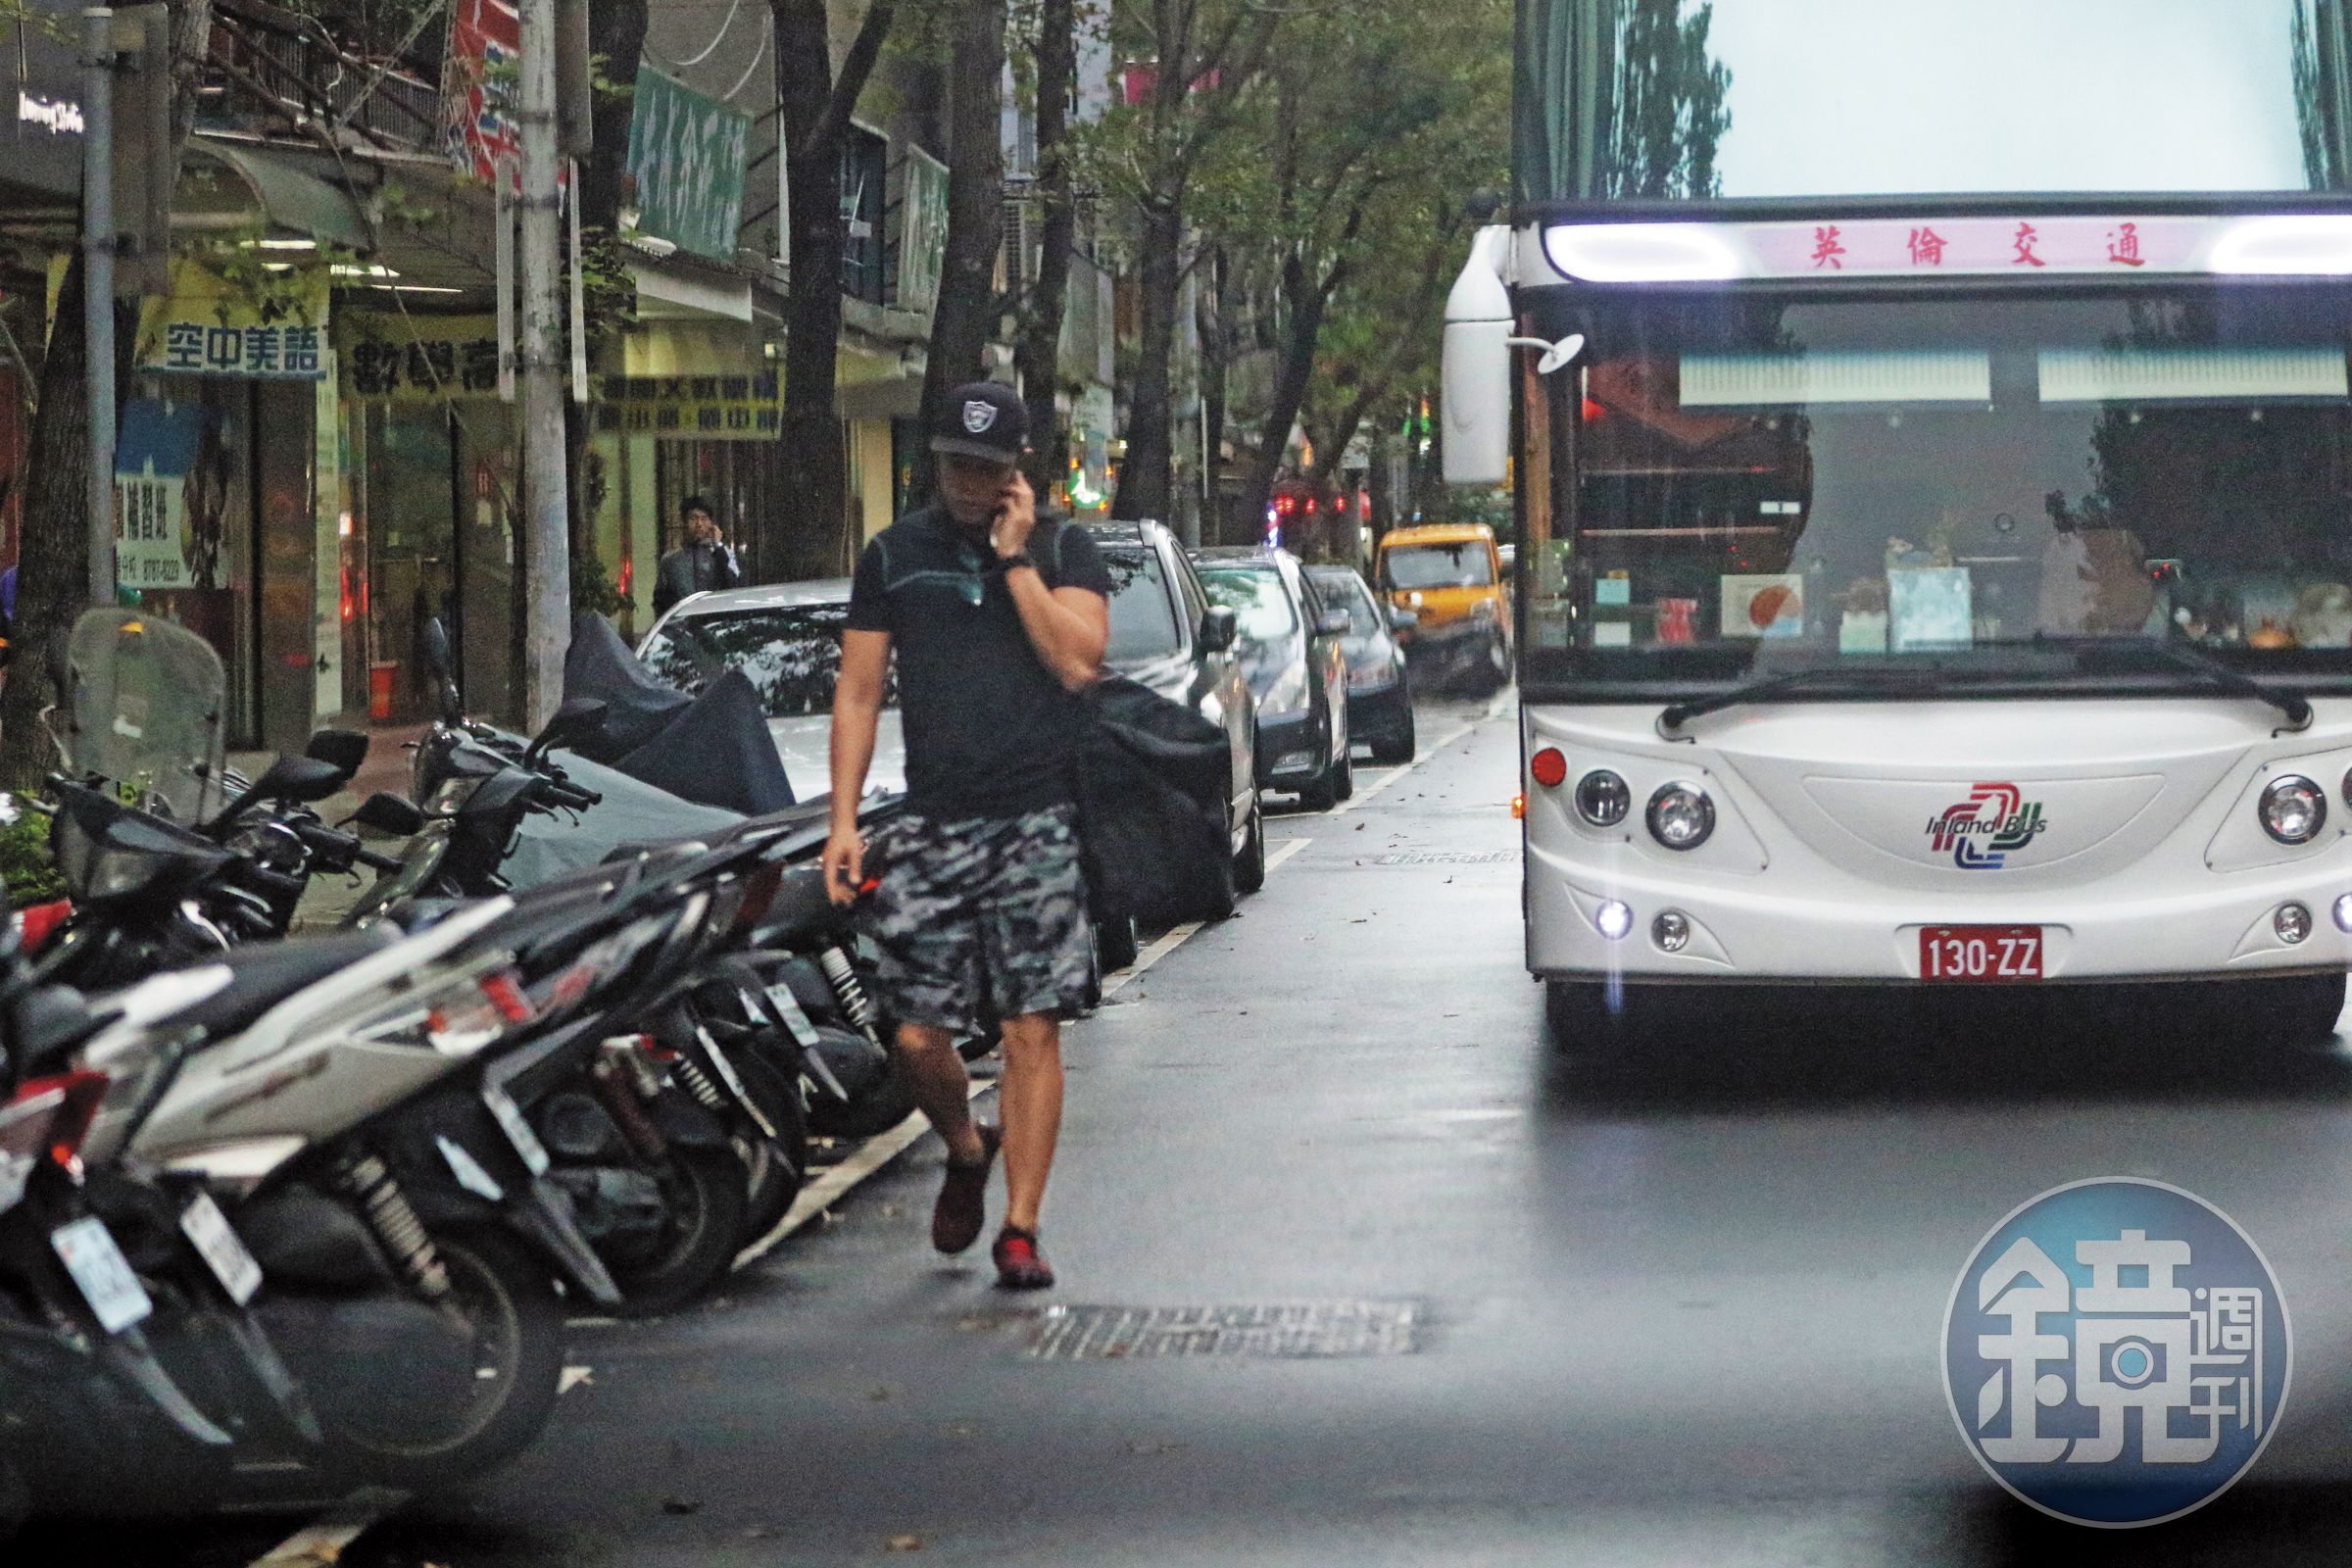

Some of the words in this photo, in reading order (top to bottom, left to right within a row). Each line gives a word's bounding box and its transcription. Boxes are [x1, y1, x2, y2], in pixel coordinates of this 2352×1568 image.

[1811, 222, 2145, 270] 英倫交通
[168, 322, 318, 370] 空中美語
[1925, 815, 2000, 834] Inland
[2003, 815, 2048, 834] Bus
[1929, 938, 2038, 977] 130-ZZ
